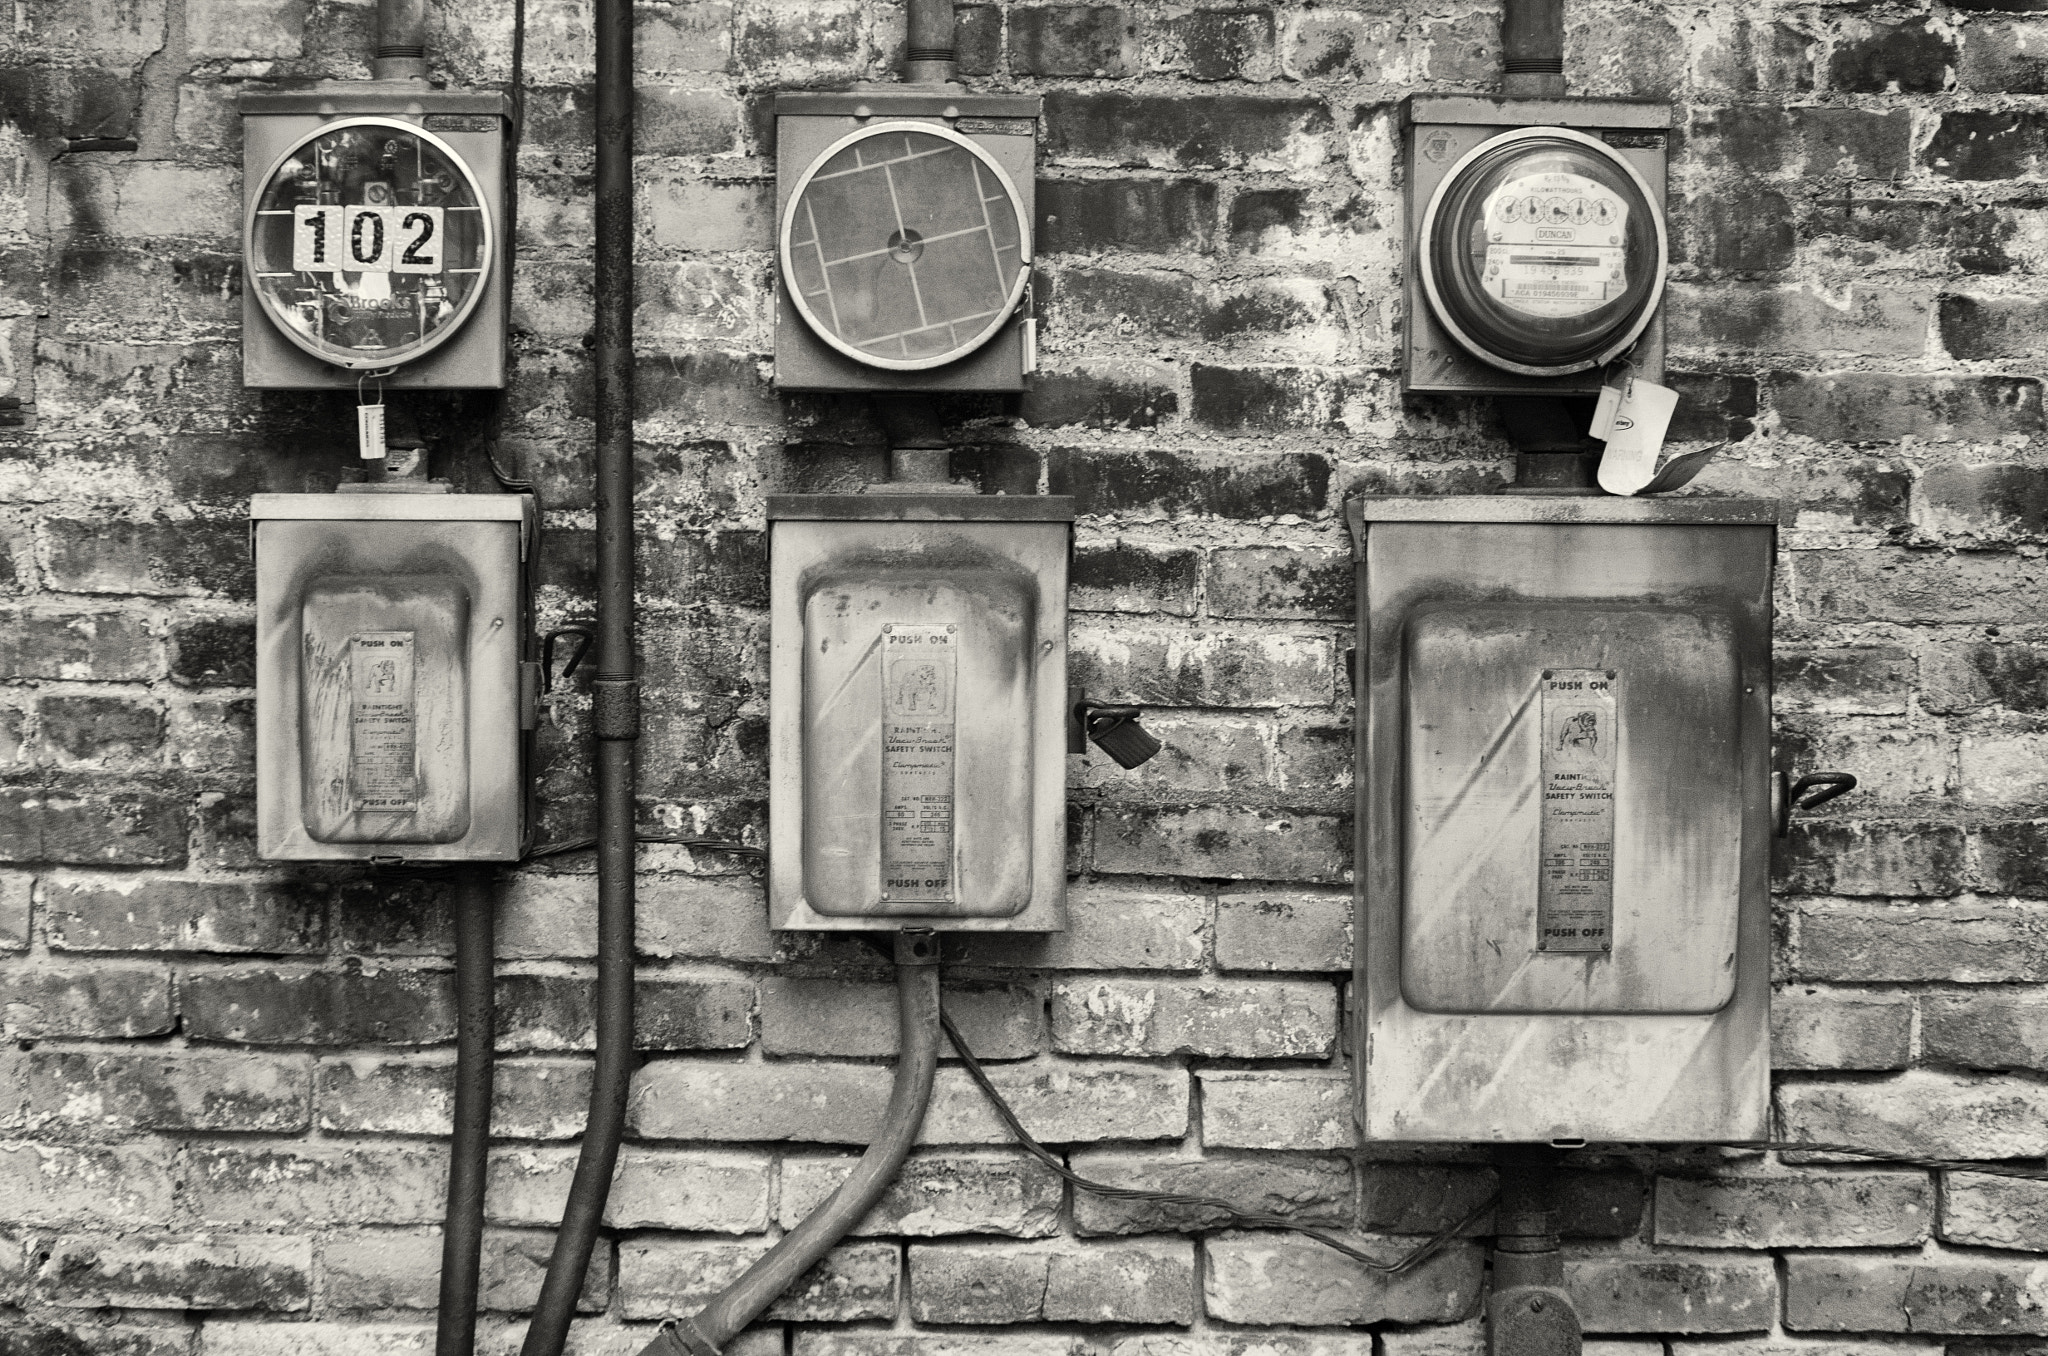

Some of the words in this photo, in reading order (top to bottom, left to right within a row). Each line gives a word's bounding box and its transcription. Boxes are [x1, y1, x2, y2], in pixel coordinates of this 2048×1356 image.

[305, 211, 433, 264] 102
[1538, 229, 1573, 240] DUNCAN
[1563, 266, 1583, 277] 939
[352, 293, 411, 310] Brooks
[361, 640, 384, 648] PUSH
[890, 635, 922, 644] PUSH
[929, 635, 948, 645] ON
[1550, 681, 1583, 690] PUSH
[1589, 681, 1608, 690] ON
[885, 745, 915, 753] SAFETY
[920, 745, 952, 753] SWITCH
[1545, 792, 1576, 800] SAFETY
[1580, 792, 1613, 800] SWITCH
[887, 879, 919, 888] PUSH
[925, 879, 948, 888] OFF
[1544, 928, 1577, 937] PUSH
[1581, 928, 1605, 937] OFF
